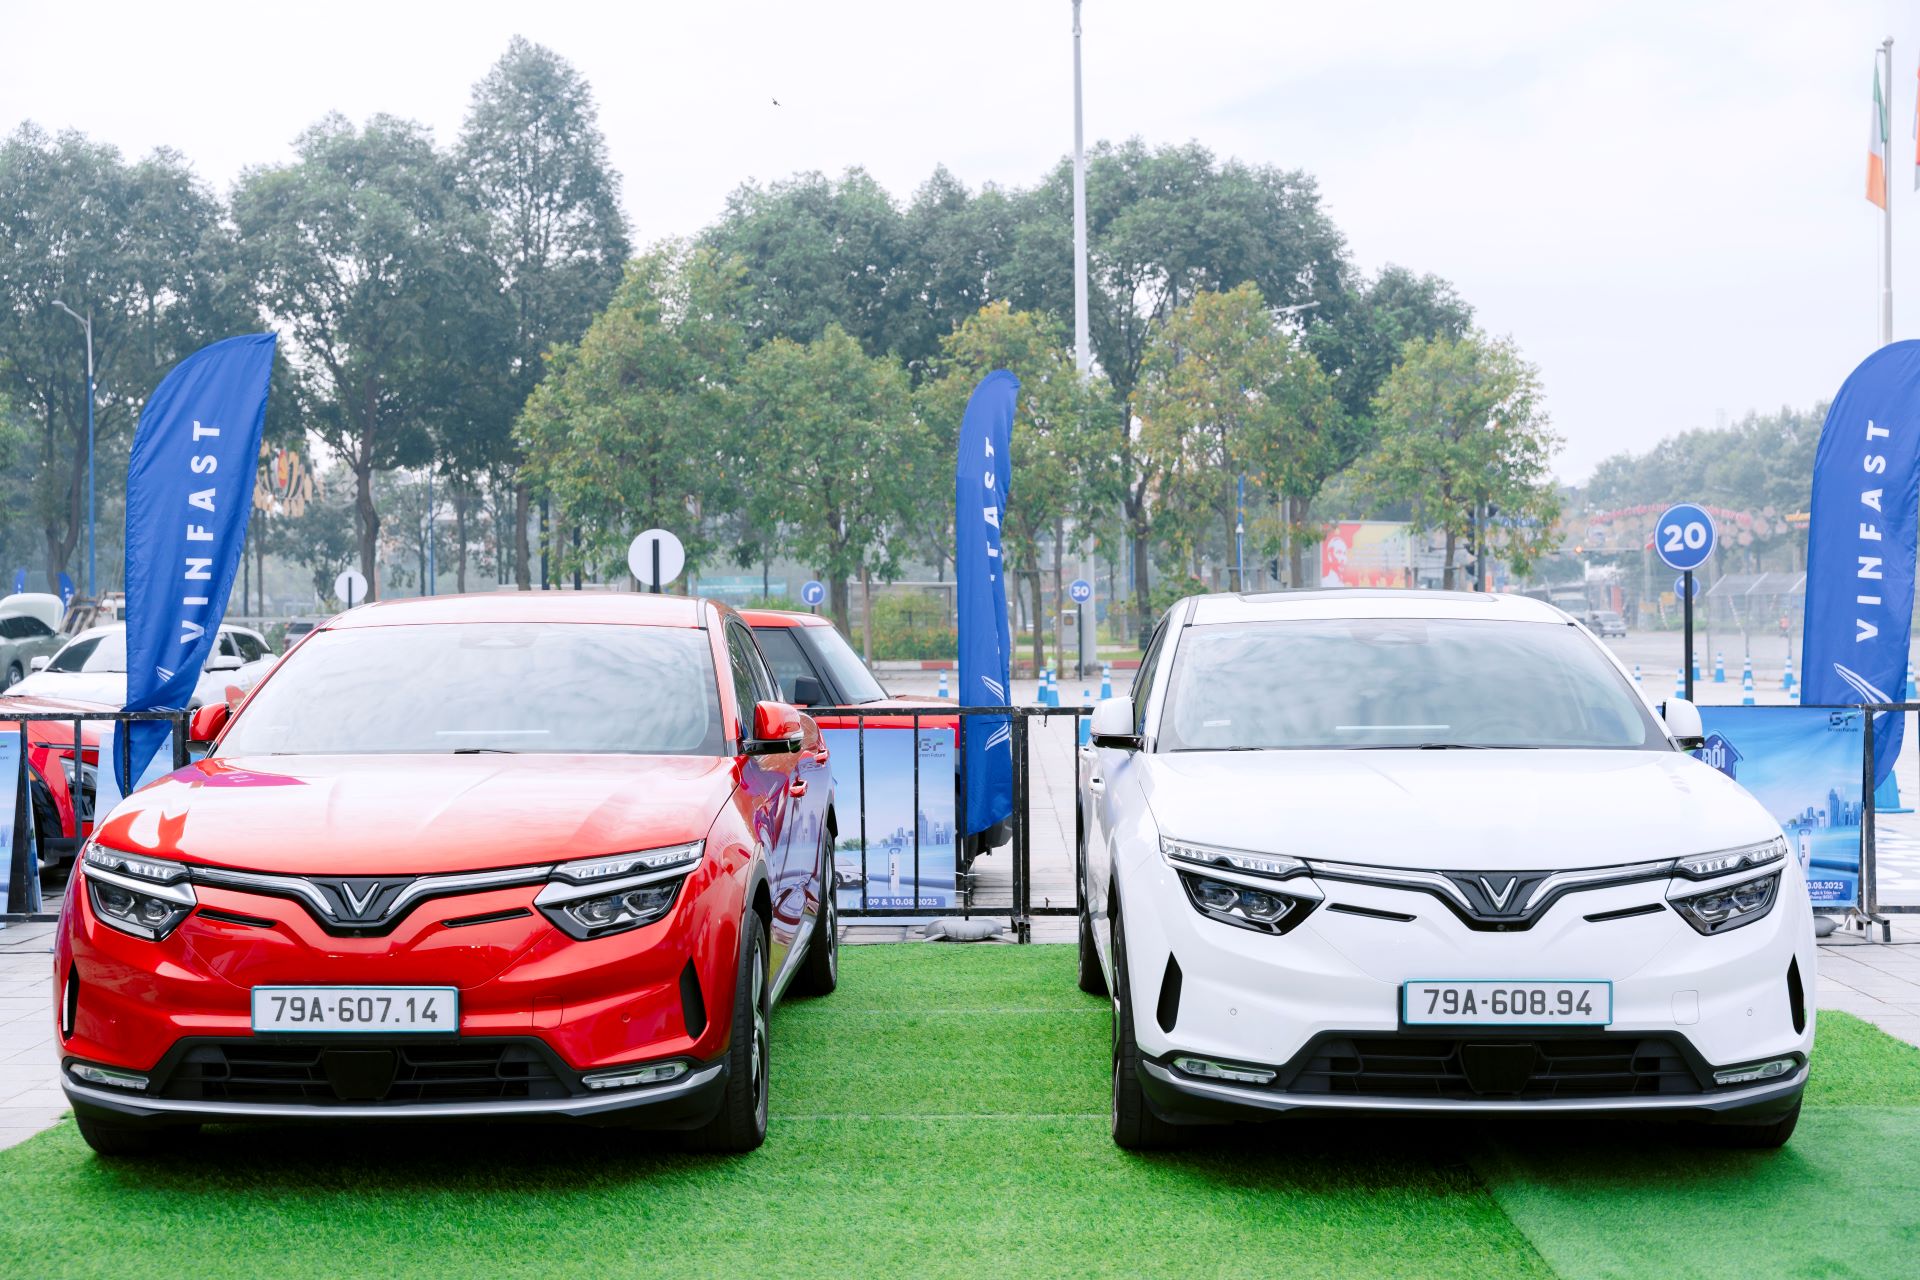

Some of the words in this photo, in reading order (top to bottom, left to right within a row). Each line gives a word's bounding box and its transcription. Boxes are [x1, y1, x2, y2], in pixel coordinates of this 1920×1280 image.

[180, 420, 221, 644] VINFAST
[1663, 521, 1707, 553] 20
[1855, 419, 1890, 643] VINFAST
[1072, 585, 1090, 597] 30
[1807, 881, 1844, 890] 0.08.2025
[868, 898, 879, 906] 09
[881, 898, 889, 906] &
[270, 996, 438, 1023] 79A-607.14
[1423, 988, 1593, 1016] 79A-608.94
